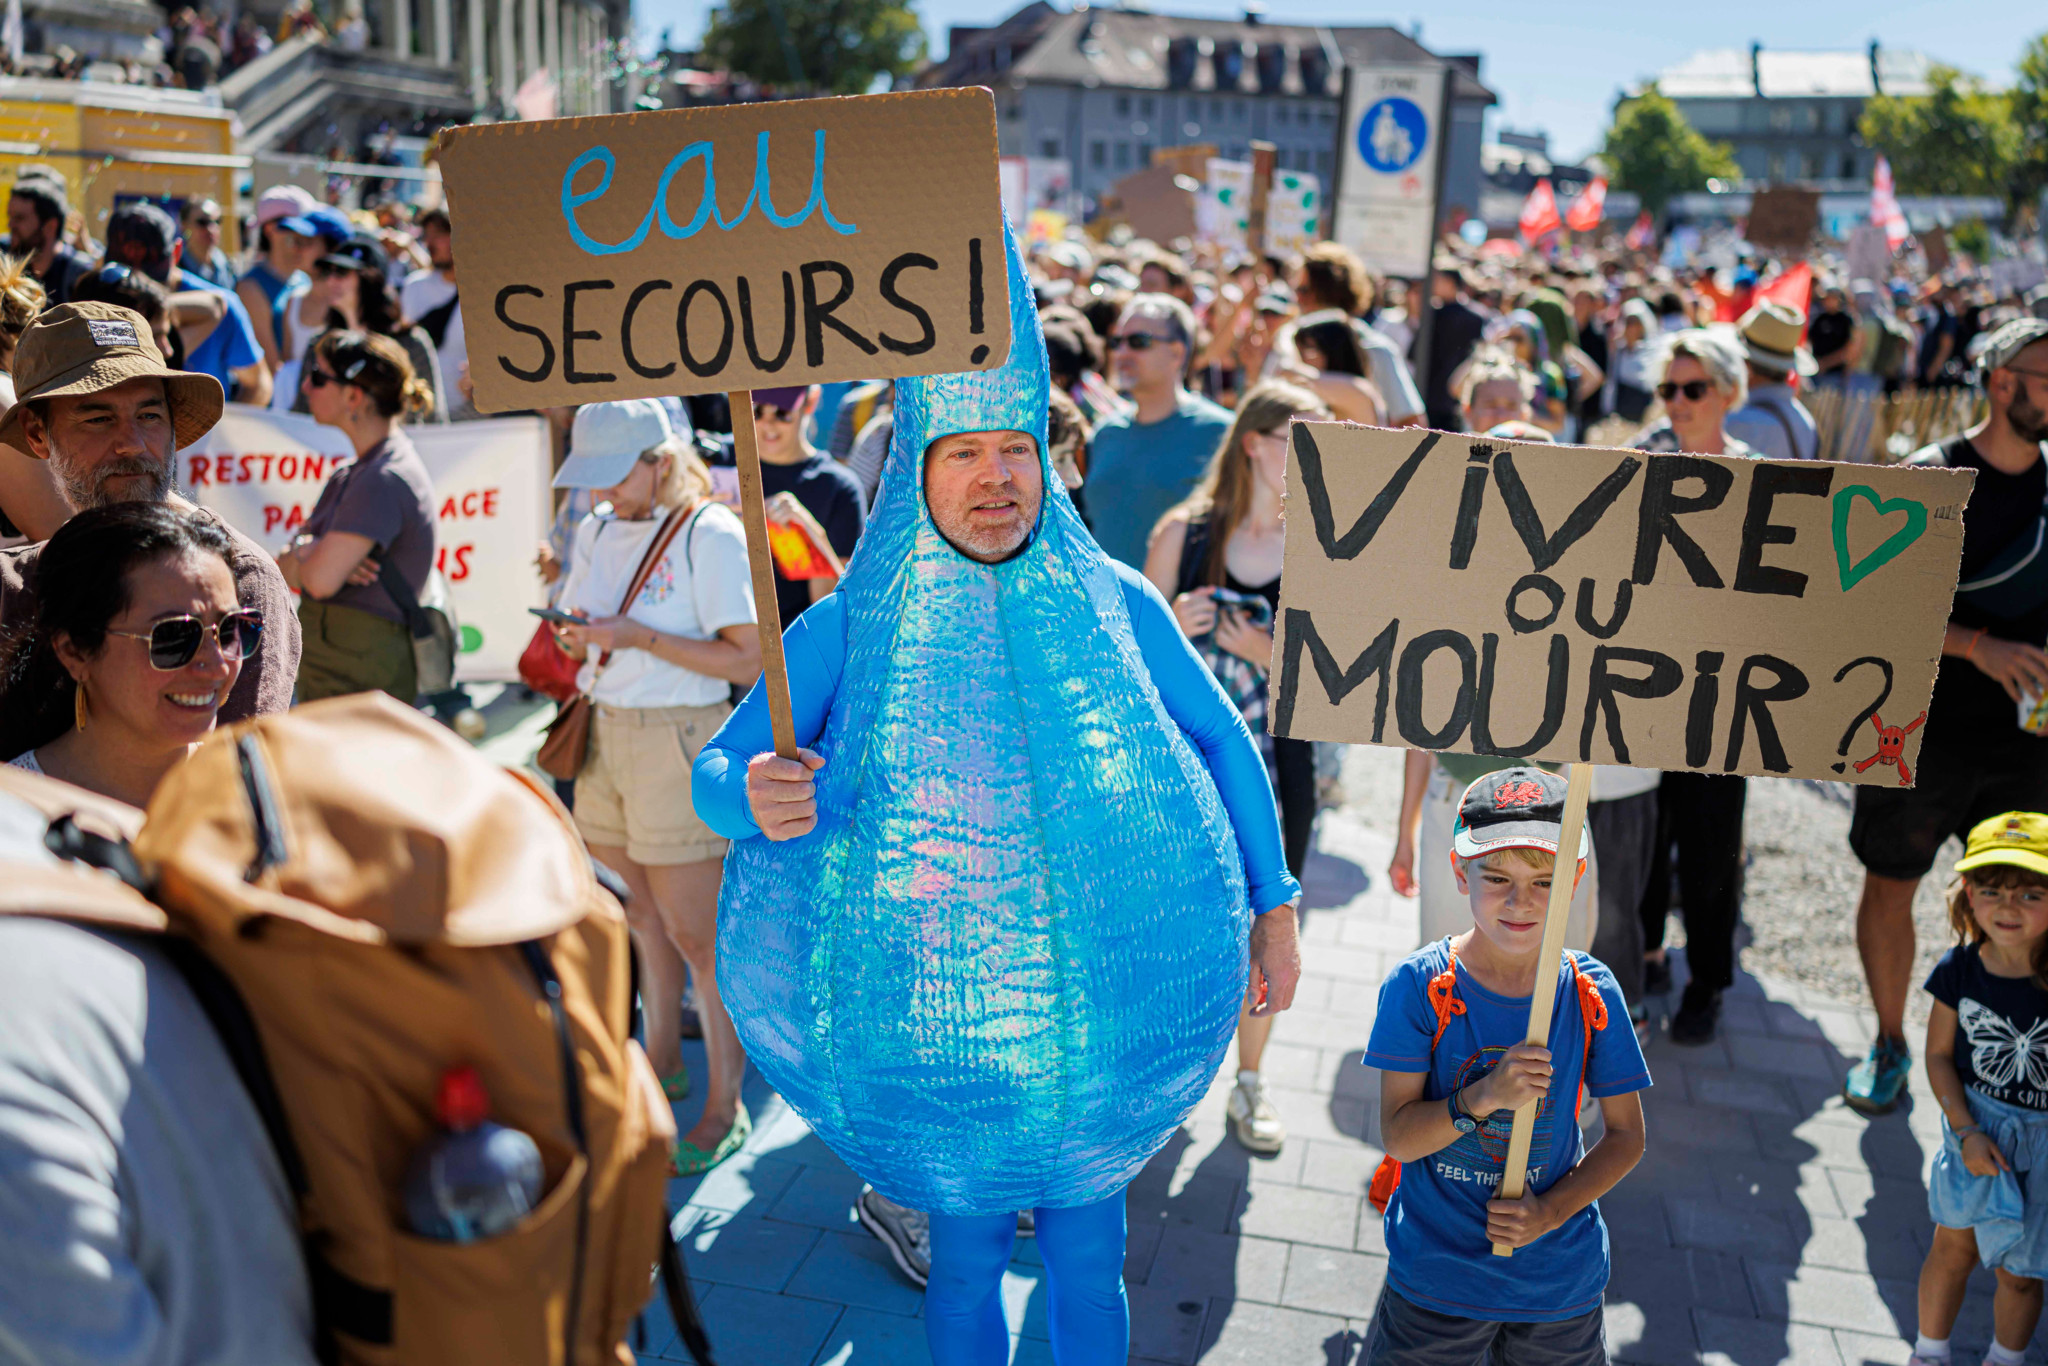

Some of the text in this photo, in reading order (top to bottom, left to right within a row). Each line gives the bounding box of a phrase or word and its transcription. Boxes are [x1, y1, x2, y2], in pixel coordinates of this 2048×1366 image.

[561, 129, 859, 256] eau
[263, 489, 500, 533] PA ACE
[1505, 574, 1632, 638] OU
[1527, 839, 1558, 851] WAL
[1437, 1163, 1542, 1186] FEEL THE AT
